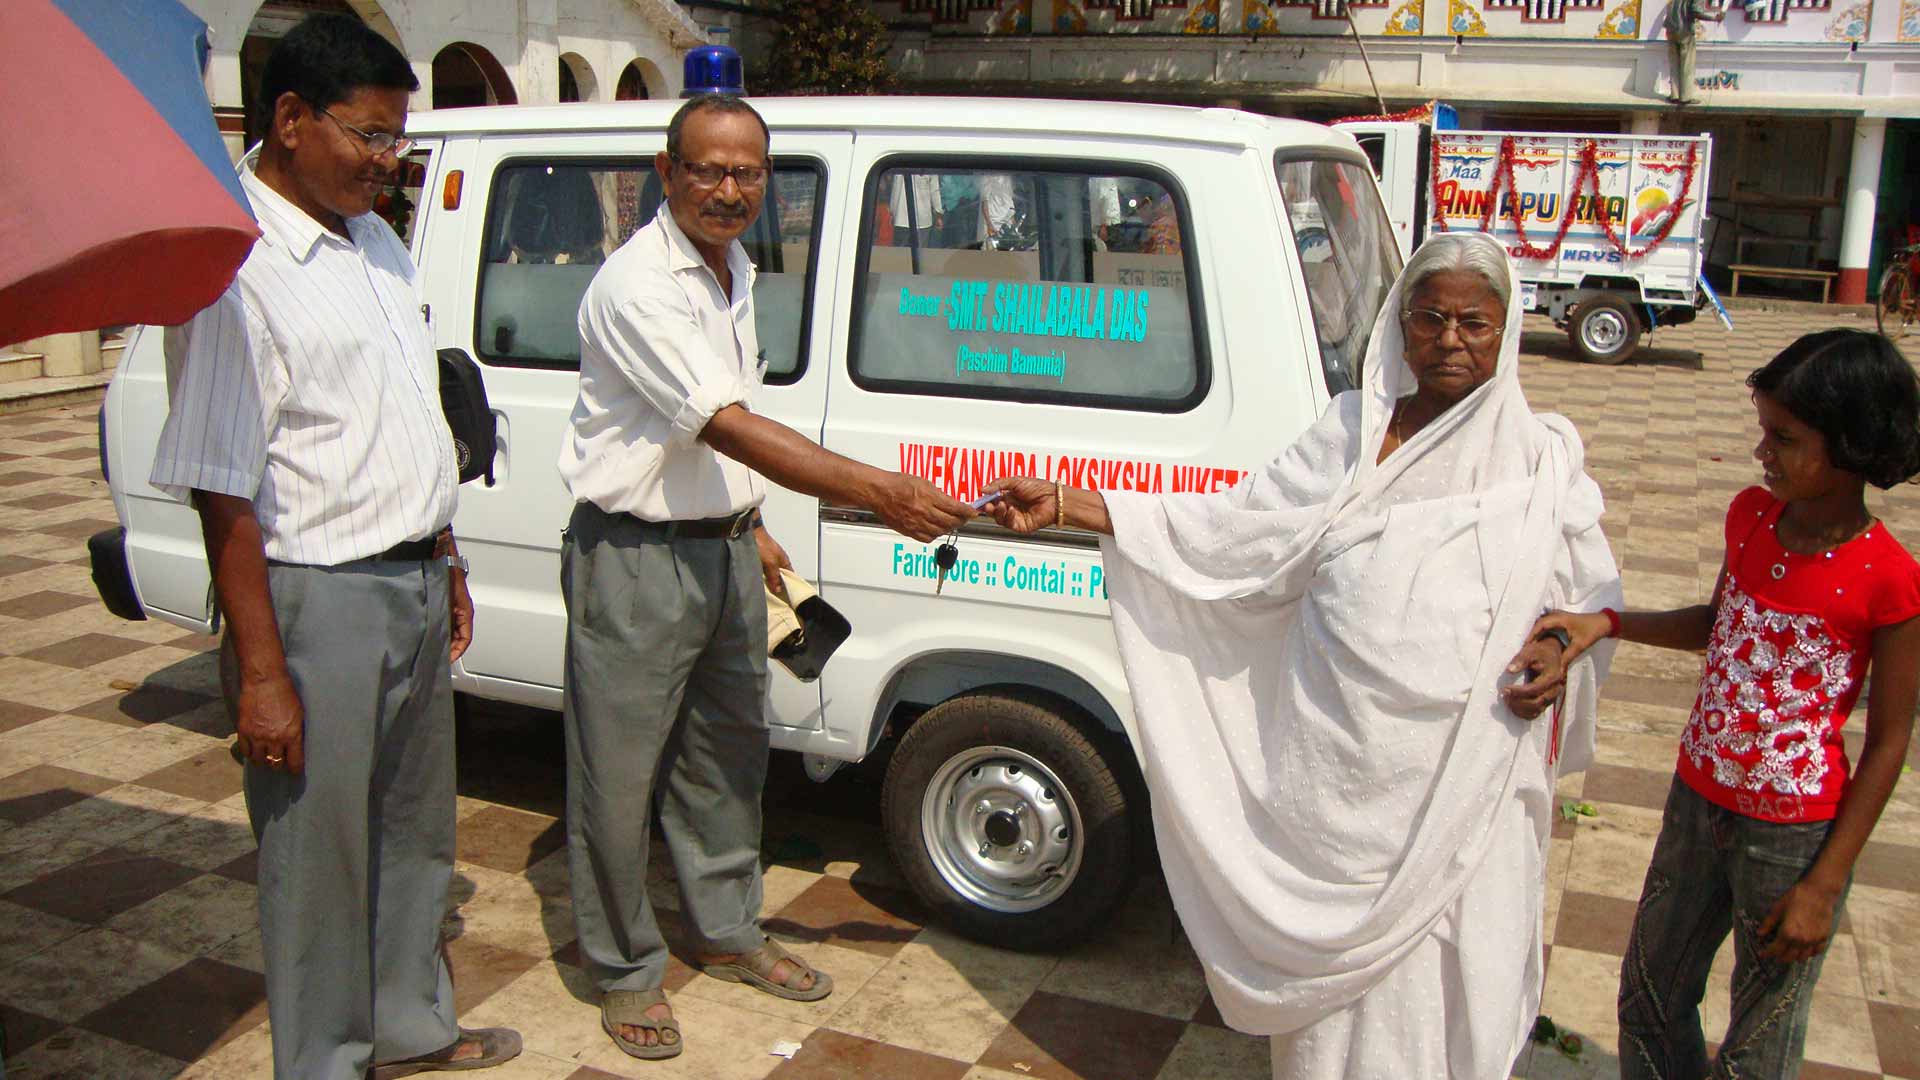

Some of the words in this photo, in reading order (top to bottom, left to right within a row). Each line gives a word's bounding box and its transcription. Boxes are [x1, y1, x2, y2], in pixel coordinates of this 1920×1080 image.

[1449, 165, 1481, 179] Maa
[991, 282, 1106, 340] SHAILABALA
[1110, 288, 1149, 343] DAS
[956, 344, 1009, 377] (Paschim
[1011, 346, 1067, 385] Bamunia)
[893, 543, 980, 585] Faridore
[1003, 554, 1066, 595] Contai
